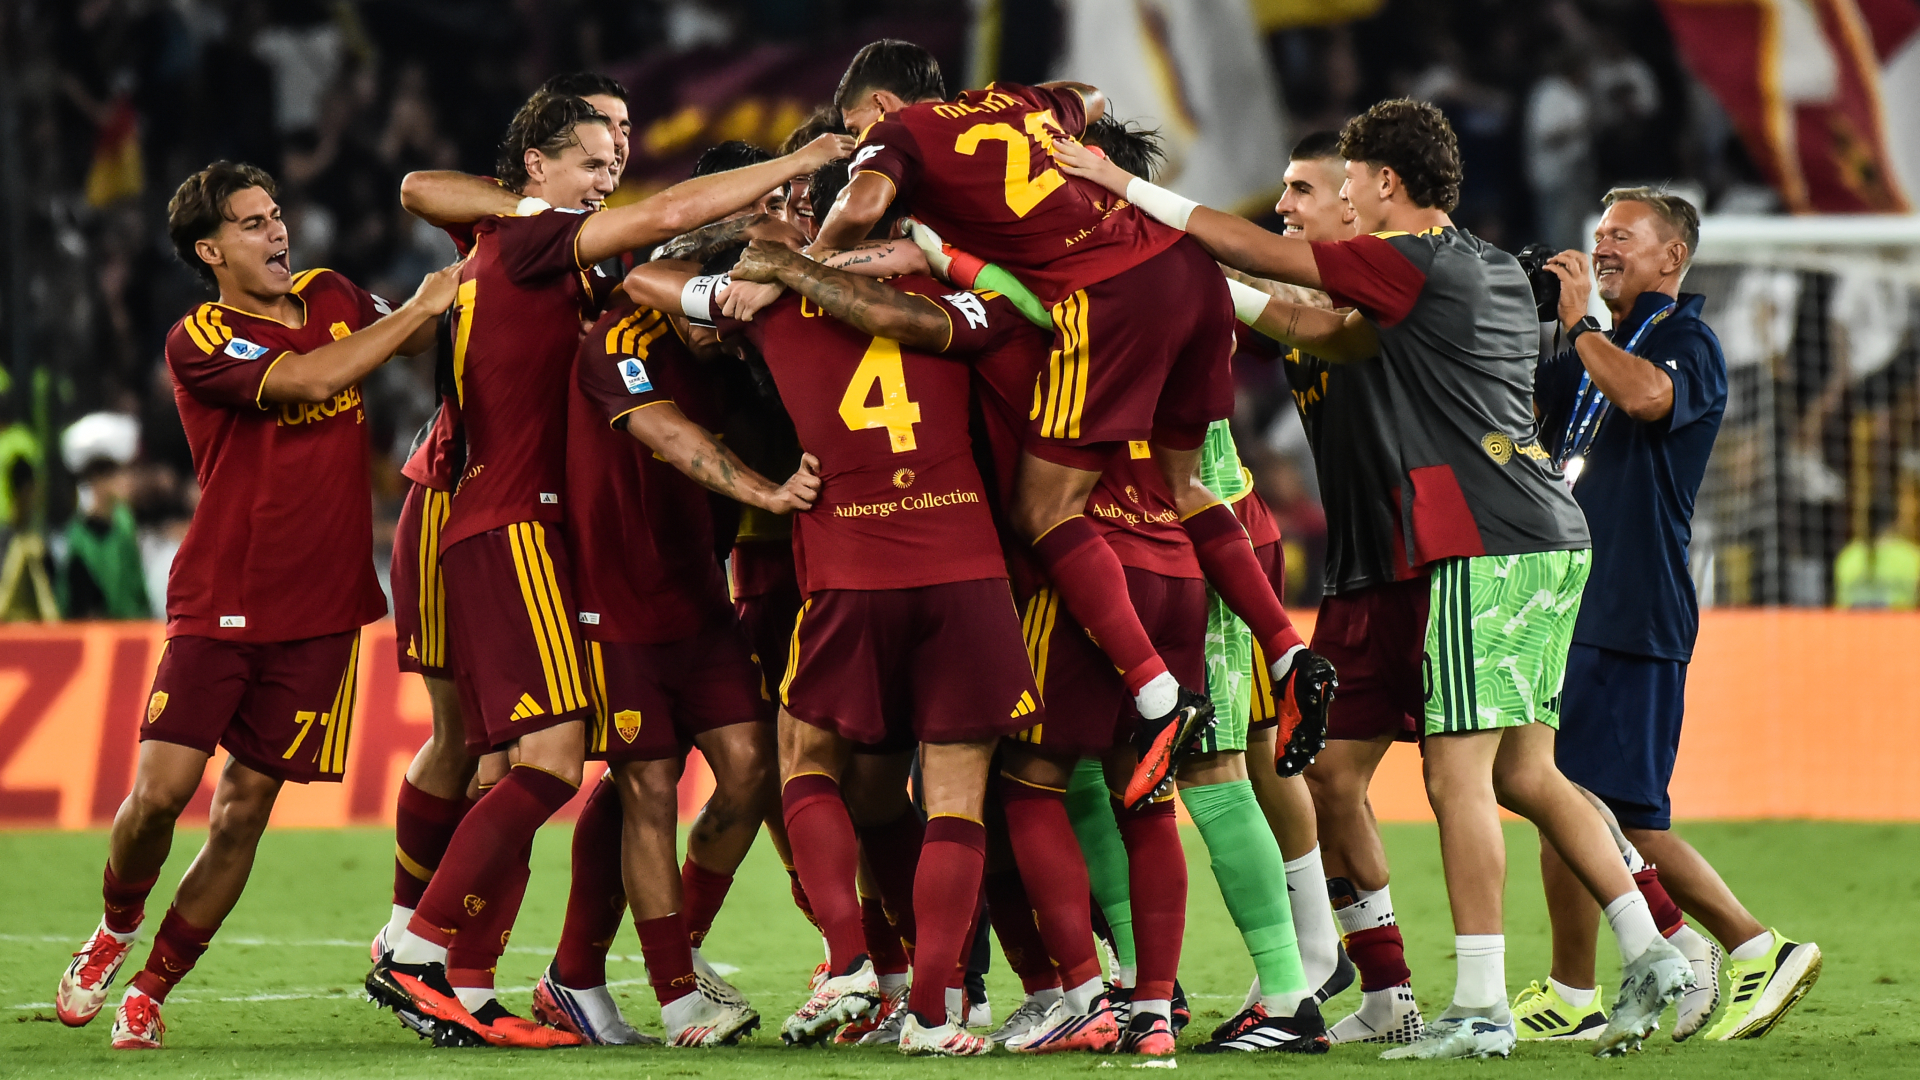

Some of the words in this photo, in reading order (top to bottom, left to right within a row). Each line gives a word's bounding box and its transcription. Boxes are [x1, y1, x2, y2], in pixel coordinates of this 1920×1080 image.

[277, 385, 361, 427] UROBE
[838, 334, 922, 454] 4
[833, 502, 898, 518] Auberge
[901, 489, 980, 511] Collection
[1092, 503, 1141, 527] Aubge
